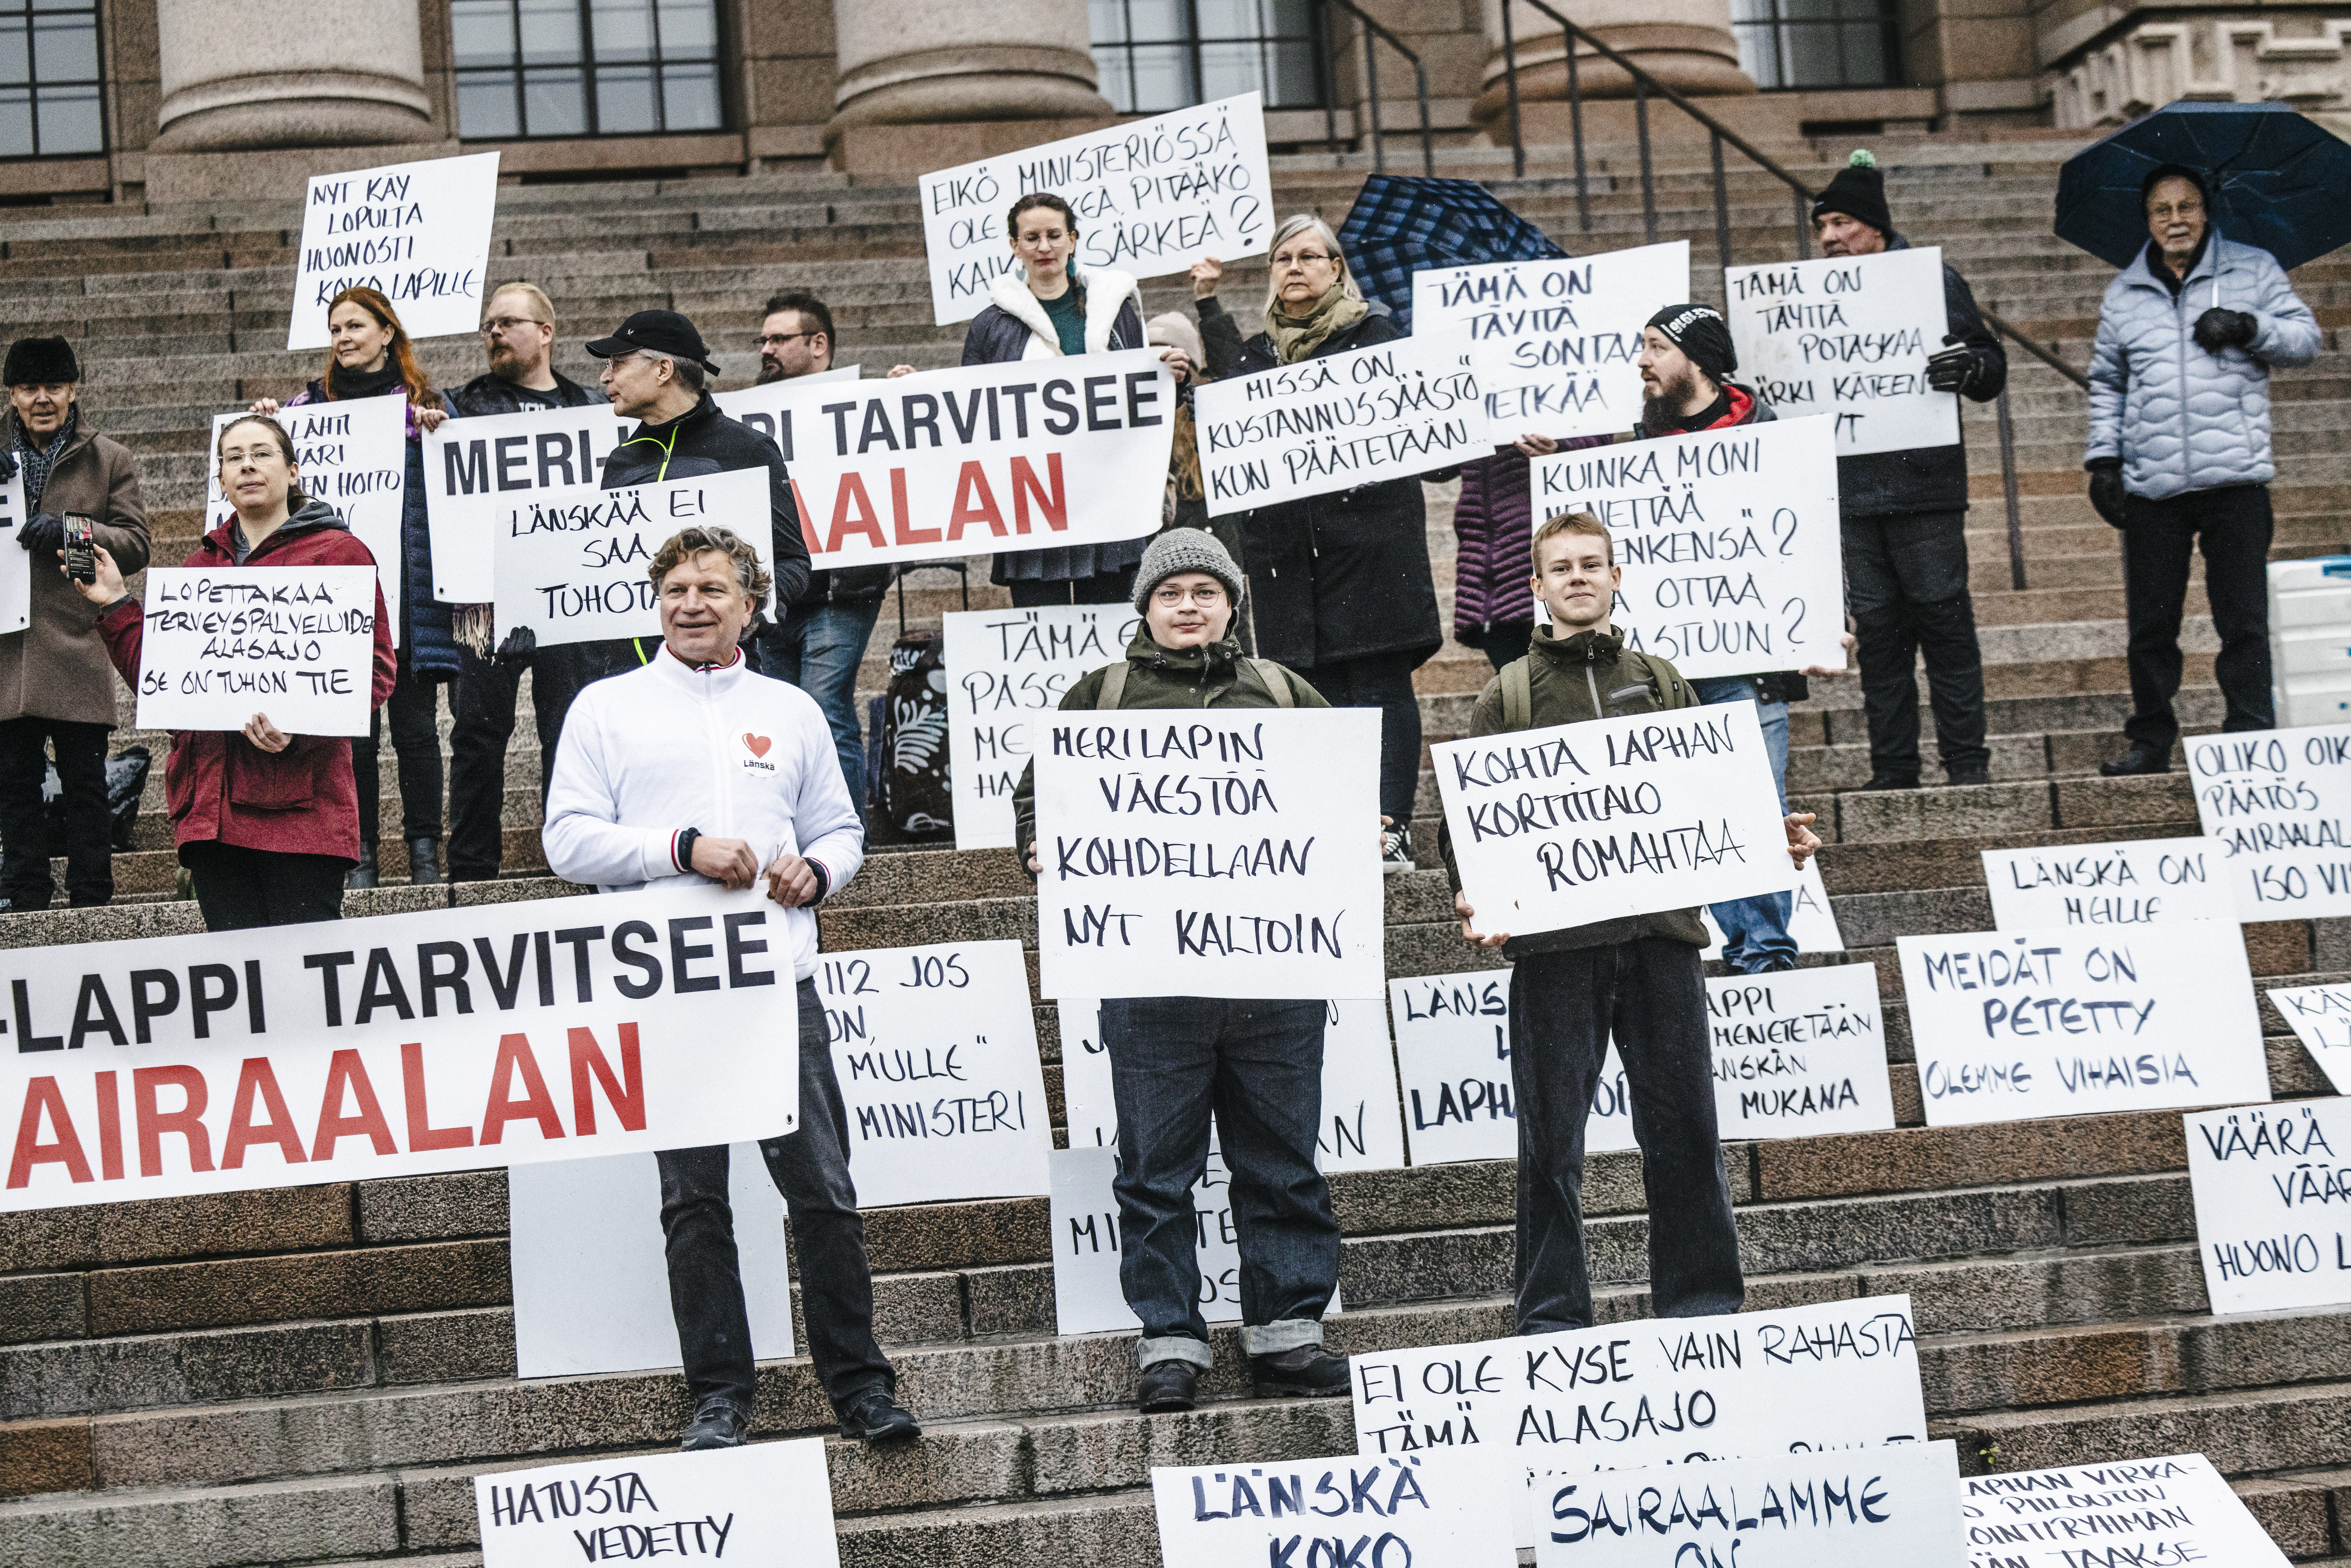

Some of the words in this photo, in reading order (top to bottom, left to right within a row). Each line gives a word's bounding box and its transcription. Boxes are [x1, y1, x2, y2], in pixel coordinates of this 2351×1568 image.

[933, 167, 999, 215] EIKÖ
[1018, 105, 1236, 196] MINISTERIÖSSÄ
[312, 180, 357, 206] NYT
[366, 172, 411, 202] KÄY
[948, 214, 999, 250] OLE
[1130, 152, 1250, 209] PITÄÄKÖ
[327, 202, 423, 235] LOPULTA
[304, 236, 413, 273] HUONOSTI
[392, 267, 482, 300] LAPILLE
[1427, 266, 1528, 308] TÄMÄ
[1542, 264, 1592, 297] ON
[1733, 267, 1804, 301] TÄMÄ
[1824, 265, 1861, 294] ON
[1458, 300, 1579, 341] TÄYTTÄ
[1756, 300, 1849, 334] TÄYTTÄ
[1798, 327, 1925, 363] POTASKAA
[1246, 360, 1340, 401] MISSÄ
[1352, 351, 1394, 384] ON
[1756, 375, 1815, 406] ÄRKI
[1833, 371, 1925, 401] KÄTEEN
[821, 370, 1163, 457] TARVITSEE
[1208, 355, 1479, 454] KUSTANNUSSÄÄSTÖ
[337, 470, 400, 498] HOITO
[1211, 459, 1270, 500] KUN
[1542, 451, 1665, 495] KUINKA
[1678, 436, 1759, 479] MONI
[512, 489, 652, 538] LÄNSKÄÄ
[669, 489, 704, 518] EI
[580, 533, 652, 568] SAA
[160, 578, 333, 607] LOPETTAKAA
[1656, 572, 1766, 609] OTTAA
[200, 635, 321, 661] ALASAJO
[985, 611, 1110, 663] TÄMÄ
[141, 669, 168, 696] SE
[180, 669, 213, 694] ON
[216, 670, 287, 694] TUHON
[295, 669, 354, 696] TIE
[744, 760, 775, 771] Länskä
[1452, 737, 1591, 791] KOHTA
[1606, 713, 1735, 767] LAPHAN
[2195, 739, 2287, 777] OLIKO
[1099, 769, 1279, 816] VÄESTÖÄ
[2202, 777, 2319, 817] PÄÄTÖS
[1056, 836, 1315, 881] KOHDELLAAN
[1537, 818, 1746, 892] ROMAHTAA
[2010, 850, 2139, 890] LÄNSKÄ
[2158, 853, 2207, 885] ON
[2251, 864, 2308, 902] ISO
[1063, 904, 1143, 947] NYT
[1175, 908, 1346, 959] KALTOIN
[303, 911, 775, 1027] TARVITSEE
[825, 959, 880, 995] 112
[899, 953, 969, 988] JOS
[1922, 937, 2062, 992] MEIDÄT
[2084, 945, 2138, 984] ON
[1714, 1003, 1872, 1047] MENETETÄÄN
[1983, 995, 2157, 1039] PETETTY
[1925, 1060, 2032, 1099] OLEMME
[2055, 1052, 2199, 1094] VIHAISIA
[856, 1090, 1025, 1141] MINISTERI
[1740, 1077, 1859, 1119] MUKANA
[2199, 1107, 2336, 1161] VÄÄRÄ
[2213, 1232, 2320, 1281] HUONO
[1358, 1364, 1404, 1405] EI
[1423, 1355, 1504, 1395] OLE
[1526, 1339, 1634, 1393] KYSE
[1658, 1328, 1741, 1373] VAIN
[1758, 1313, 1916, 1366] RAHASTA
[1362, 1400, 1480, 1454] TÄMÄ
[1516, 1389, 1716, 1447] ALASAJO
[490, 1472, 660, 1527] HATUSTA
[1191, 1455, 1431, 1523] LÄNSKÄ
[1550, 1474, 1892, 1544] SAIRAALAMME
[573, 1512, 734, 1564] VEDETTY
